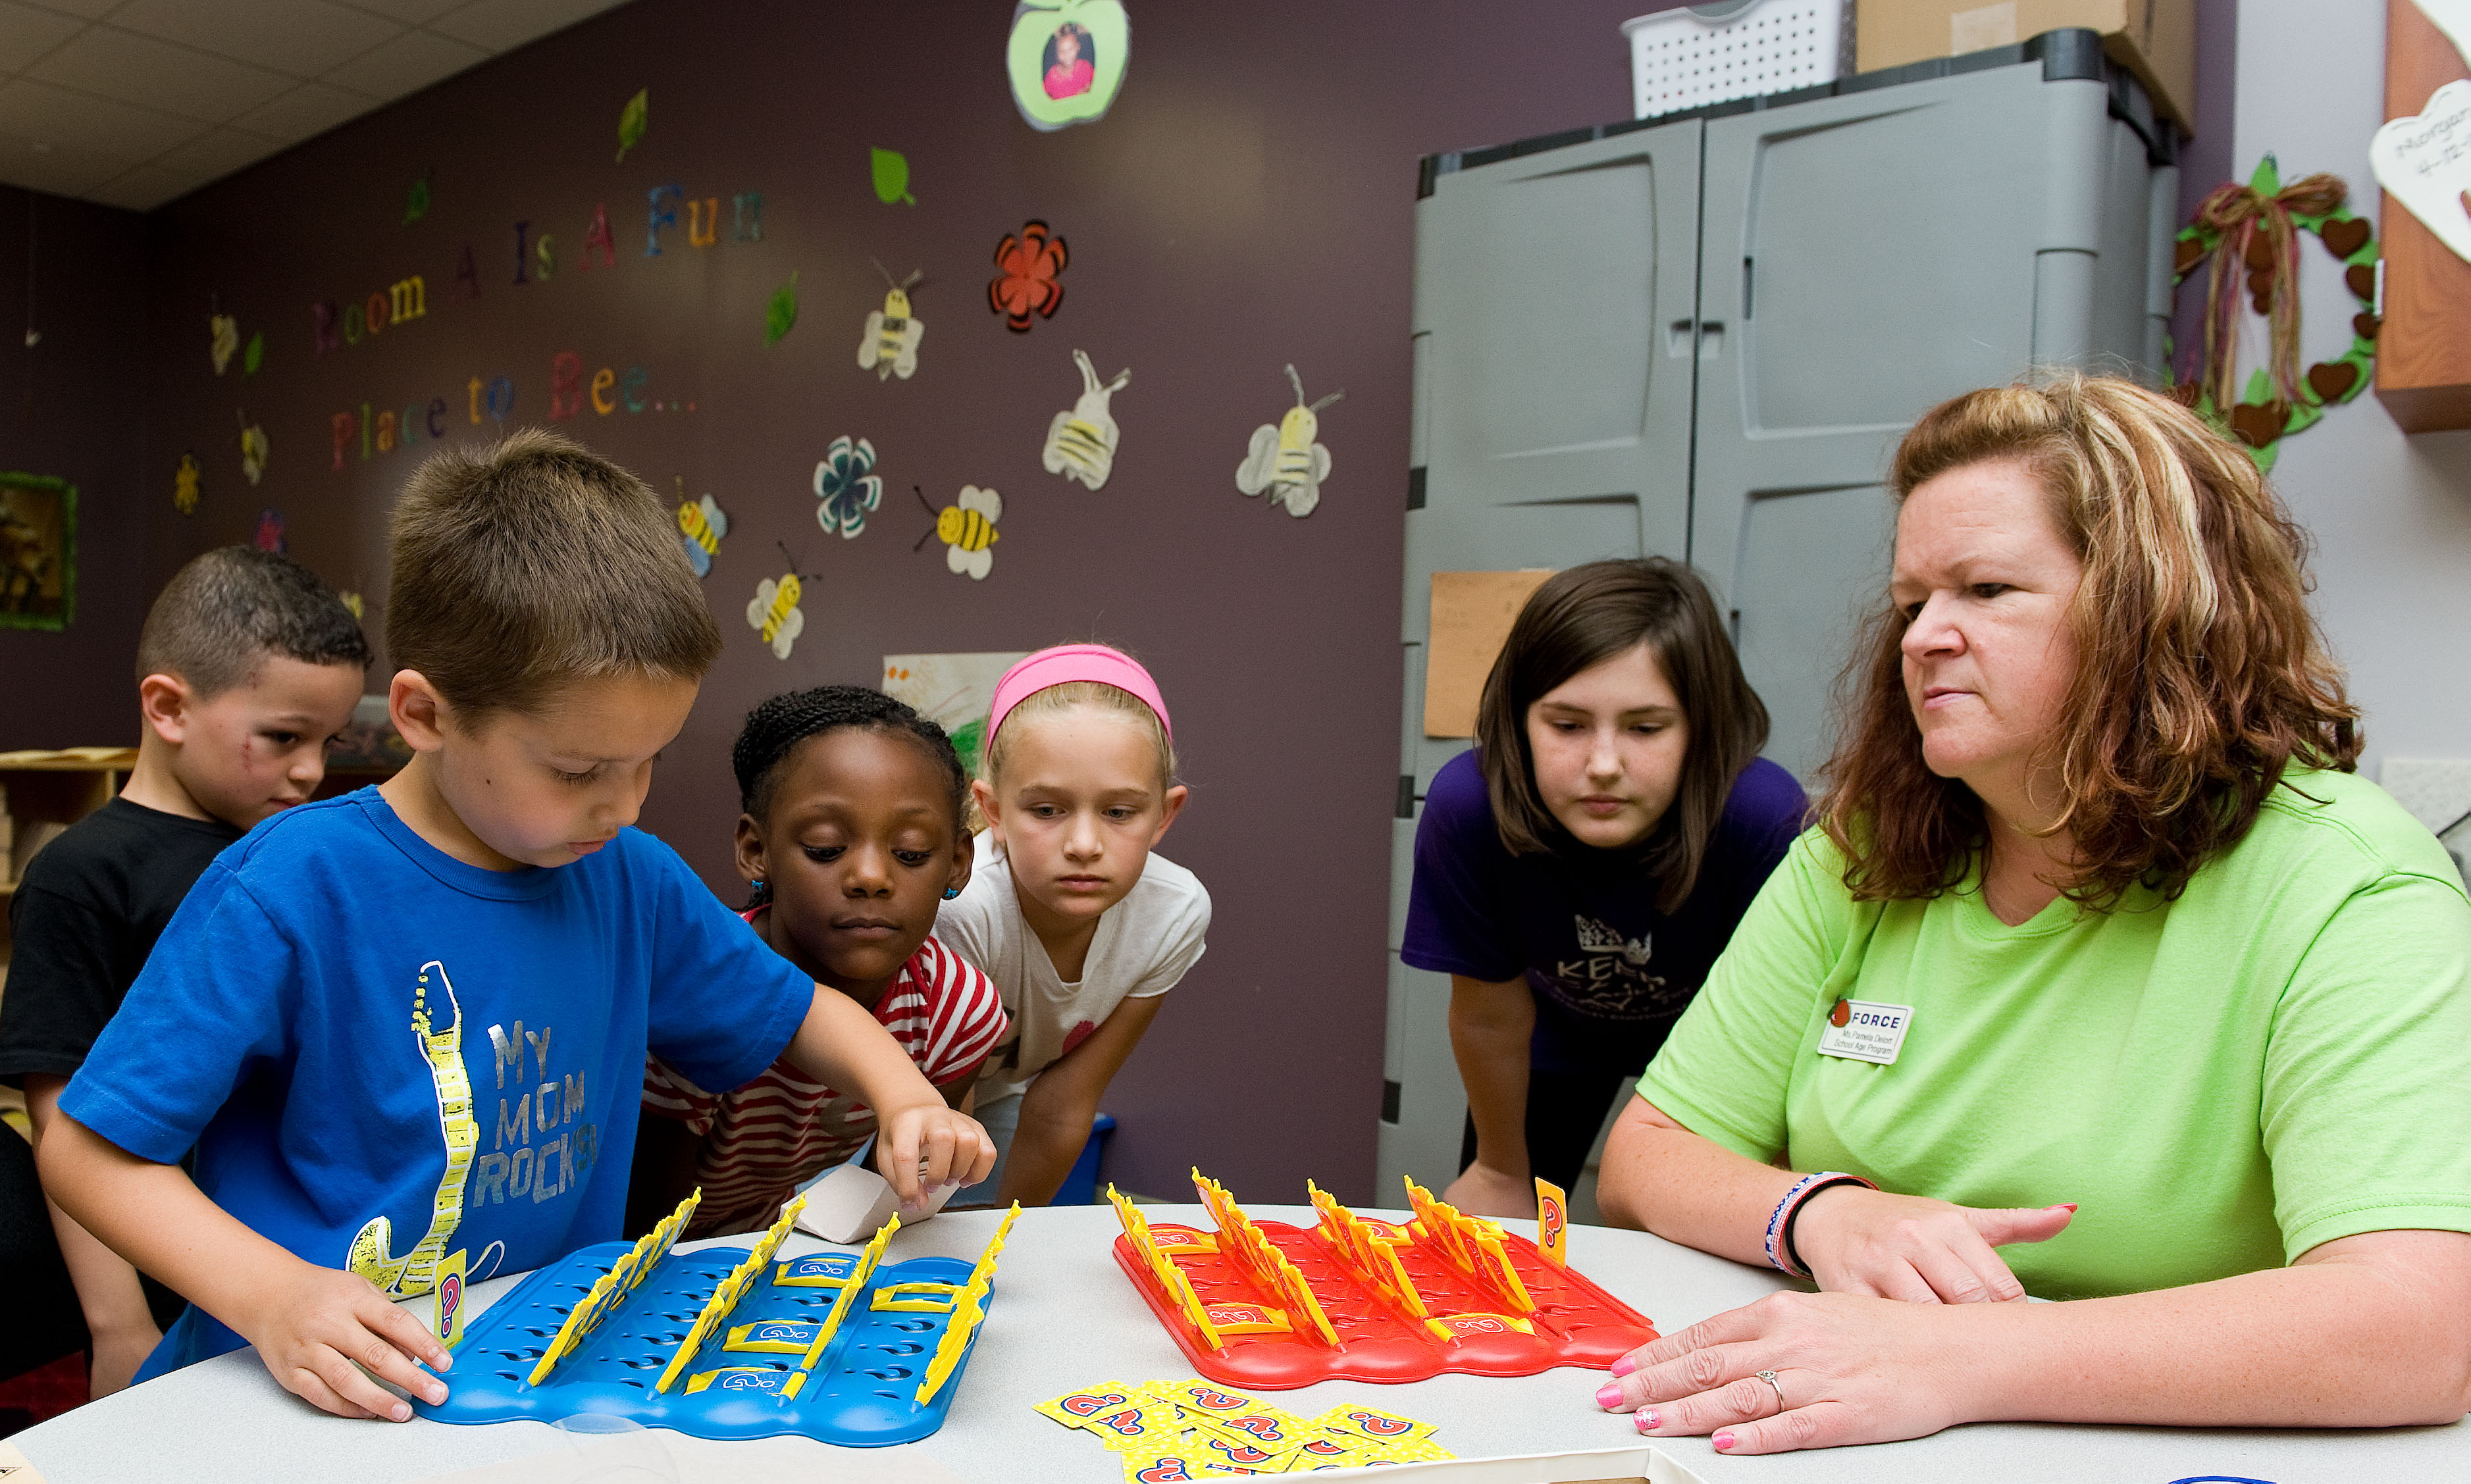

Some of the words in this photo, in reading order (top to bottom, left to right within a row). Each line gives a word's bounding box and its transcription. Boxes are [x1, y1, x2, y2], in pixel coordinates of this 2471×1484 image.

[312, 273, 427, 356] Room
[451, 244, 482, 303] A
[513, 220, 556, 284] Is
[578, 203, 617, 272] A
[644, 182, 764, 257] Fun
[467, 374, 513, 425] to
[1851, 1011, 1901, 1029] FORCE
[1852, 1030, 1874, 1042] Pamela
[487, 1020, 552, 1090] MY
[1834, 1038, 1855, 1048] School
[1854, 1042, 1867, 1052] Age
[1866, 1044, 1892, 1055] Program
[495, 1070, 586, 1150] MOM
